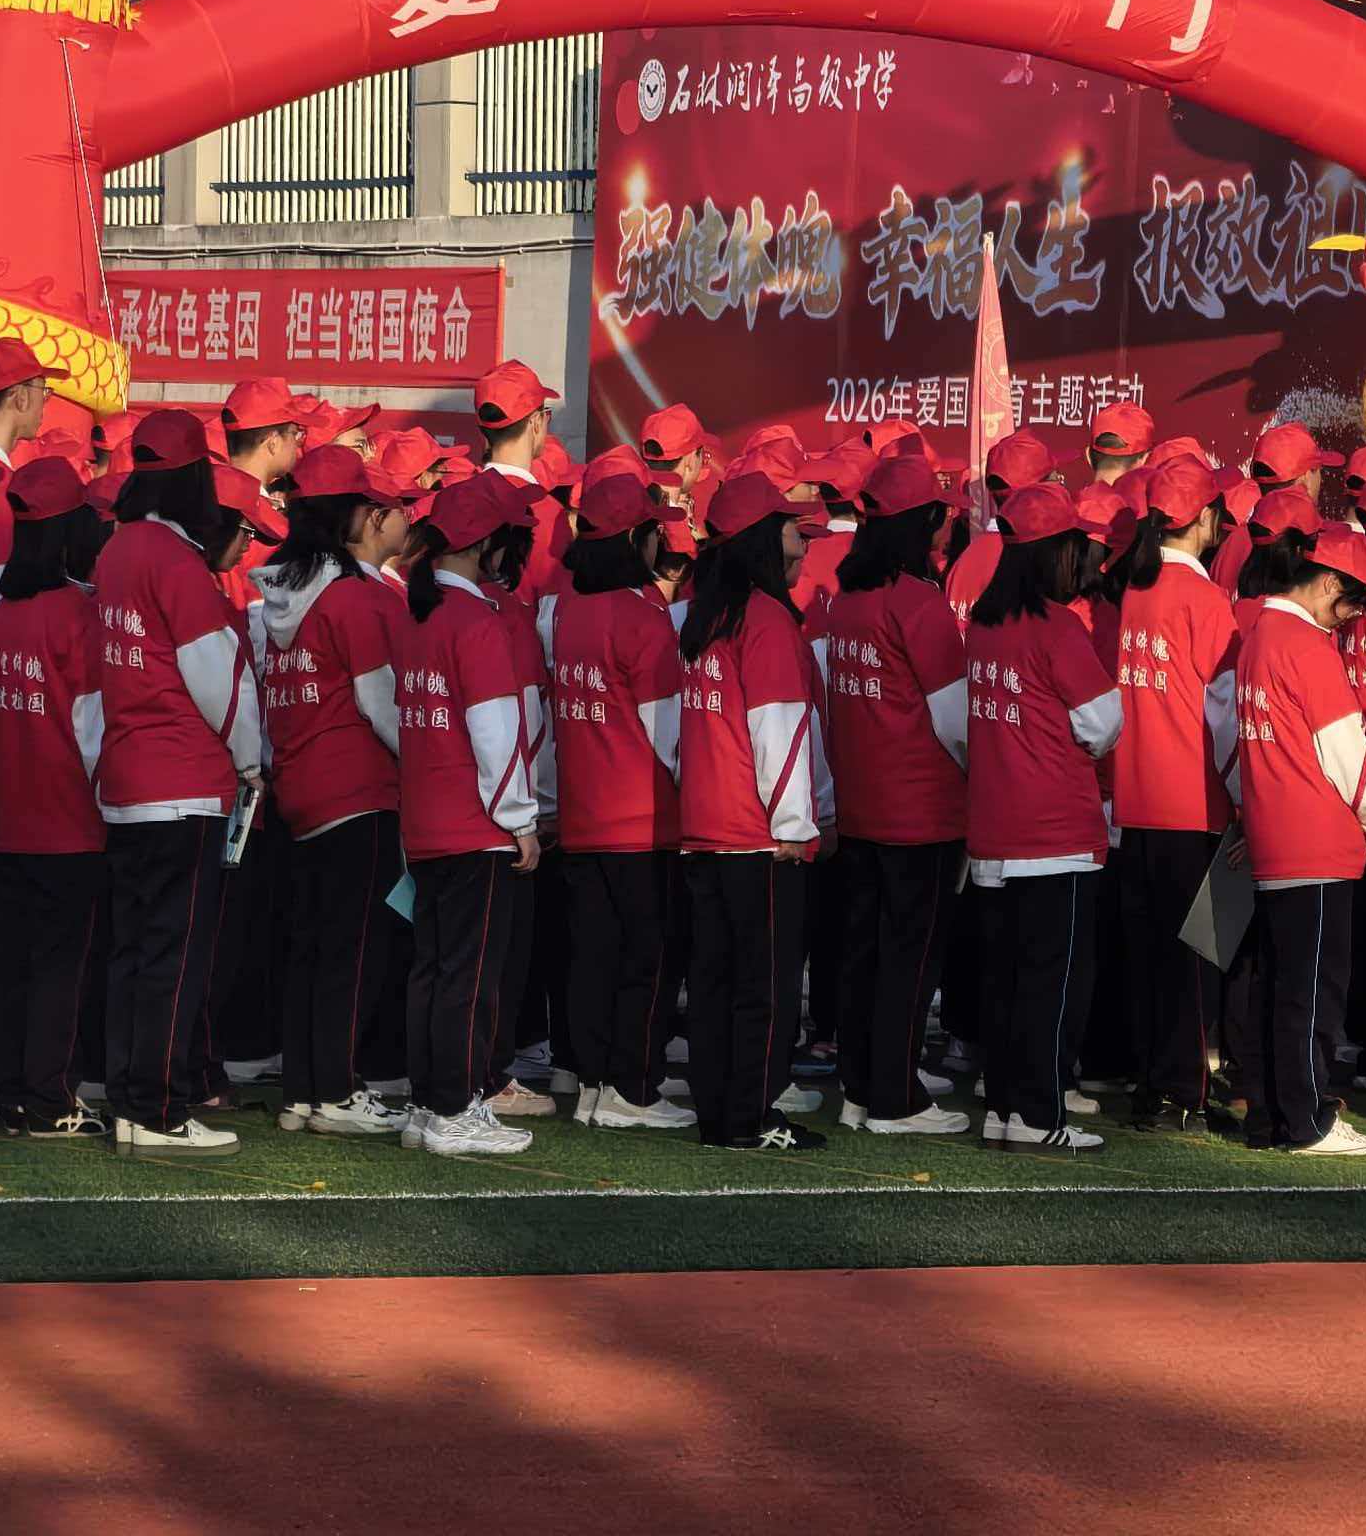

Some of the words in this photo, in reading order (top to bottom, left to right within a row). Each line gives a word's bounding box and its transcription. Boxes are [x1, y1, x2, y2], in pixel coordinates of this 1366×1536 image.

[668, 49, 897, 115] 石林润泽高级中学
[617, 188, 843, 331] 强健体魄
[862, 183, 1106, 341] 幸福人生
[100, 288, 261, 362] 承红色基因
[285, 285, 473, 363] 担当强国使命
[825, 373, 1146, 428] 2026年爱国育主题活动
